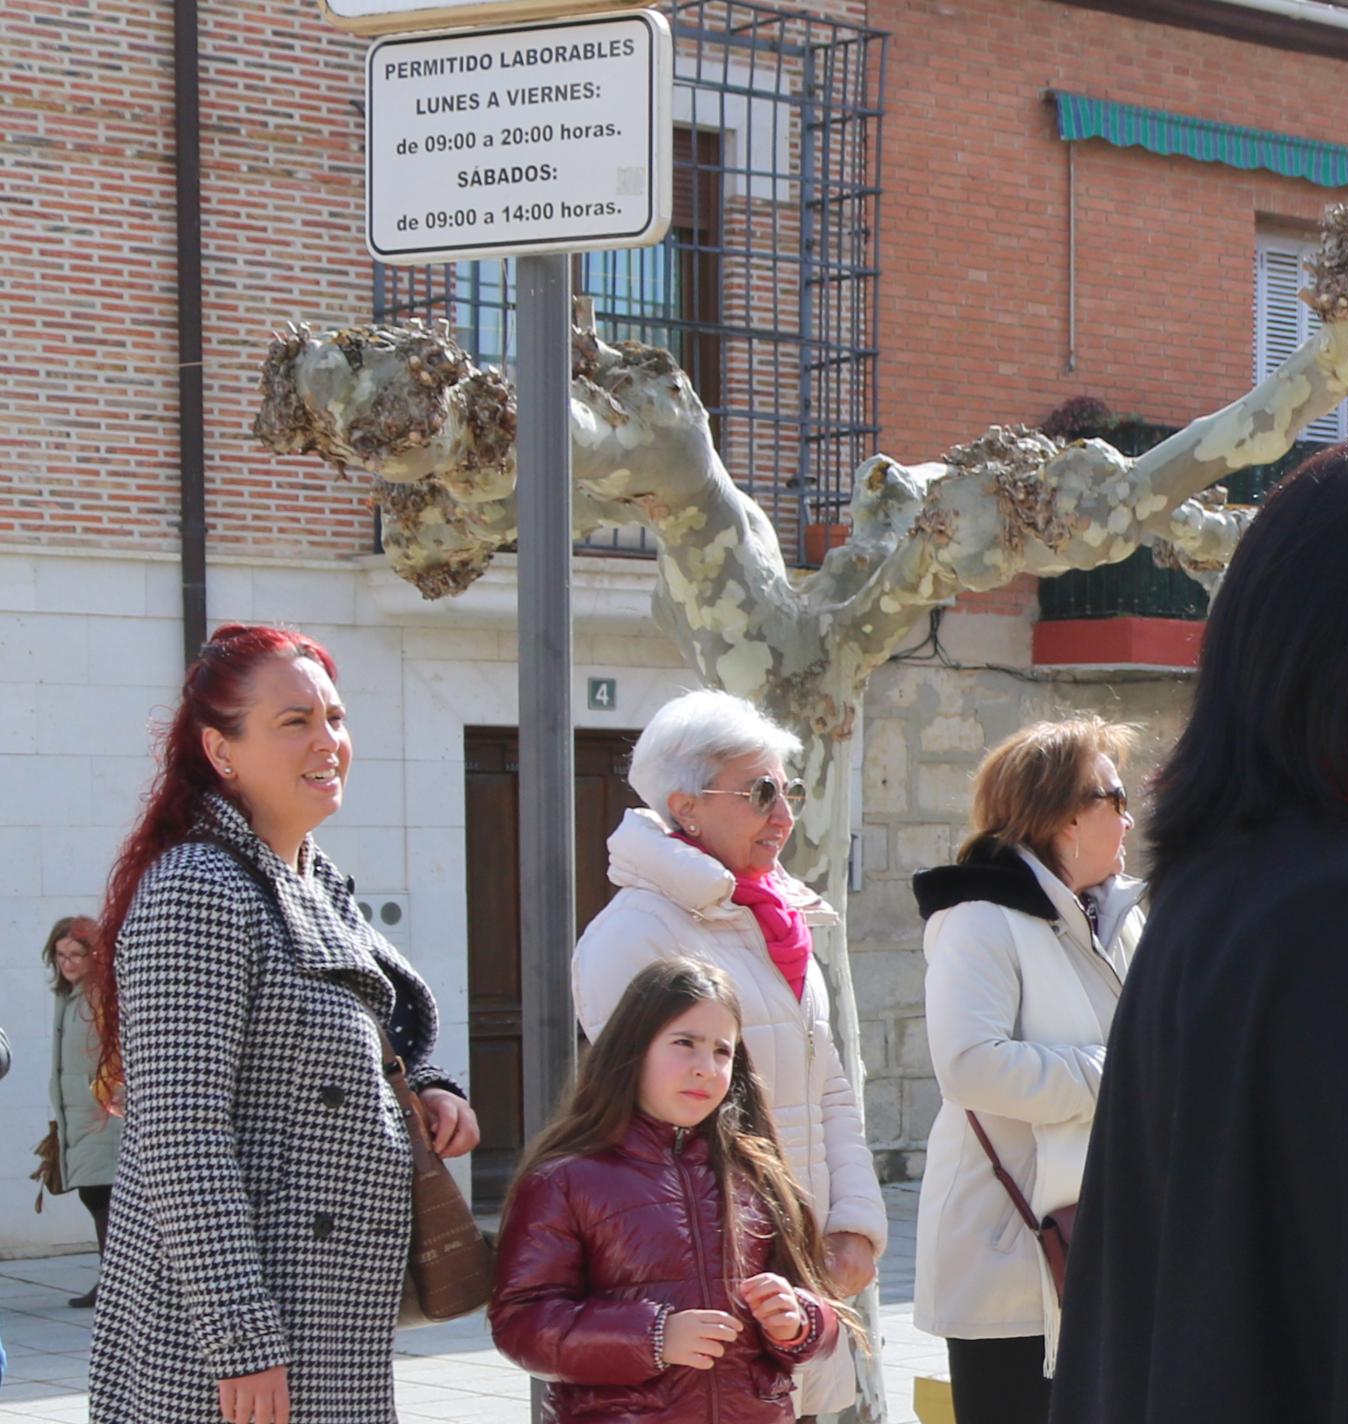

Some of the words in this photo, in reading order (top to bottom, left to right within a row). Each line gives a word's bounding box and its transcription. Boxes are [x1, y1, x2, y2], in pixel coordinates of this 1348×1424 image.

[385, 53, 493, 80] PERMITIDO
[500, 38, 635, 69] LABORABLES
[416, 93, 480, 115] LUNES
[487, 92, 500, 108] A
[507, 82, 601, 106] VIERNES:
[396, 138, 418, 155] de
[425, 132, 476, 152] 09:00
[482, 135, 494, 148] a
[501, 124, 553, 146] 20:00
[560, 121, 622, 140] horas.
[457, 163, 558, 188] SÁBADOS:
[397, 214, 418, 232] de
[426, 209, 477, 229] 09:00
[483, 212, 494, 225] a
[502, 202, 554, 223] 14:00
[561, 199, 622, 219] horas.
[595, 682, 609, 706] 4
